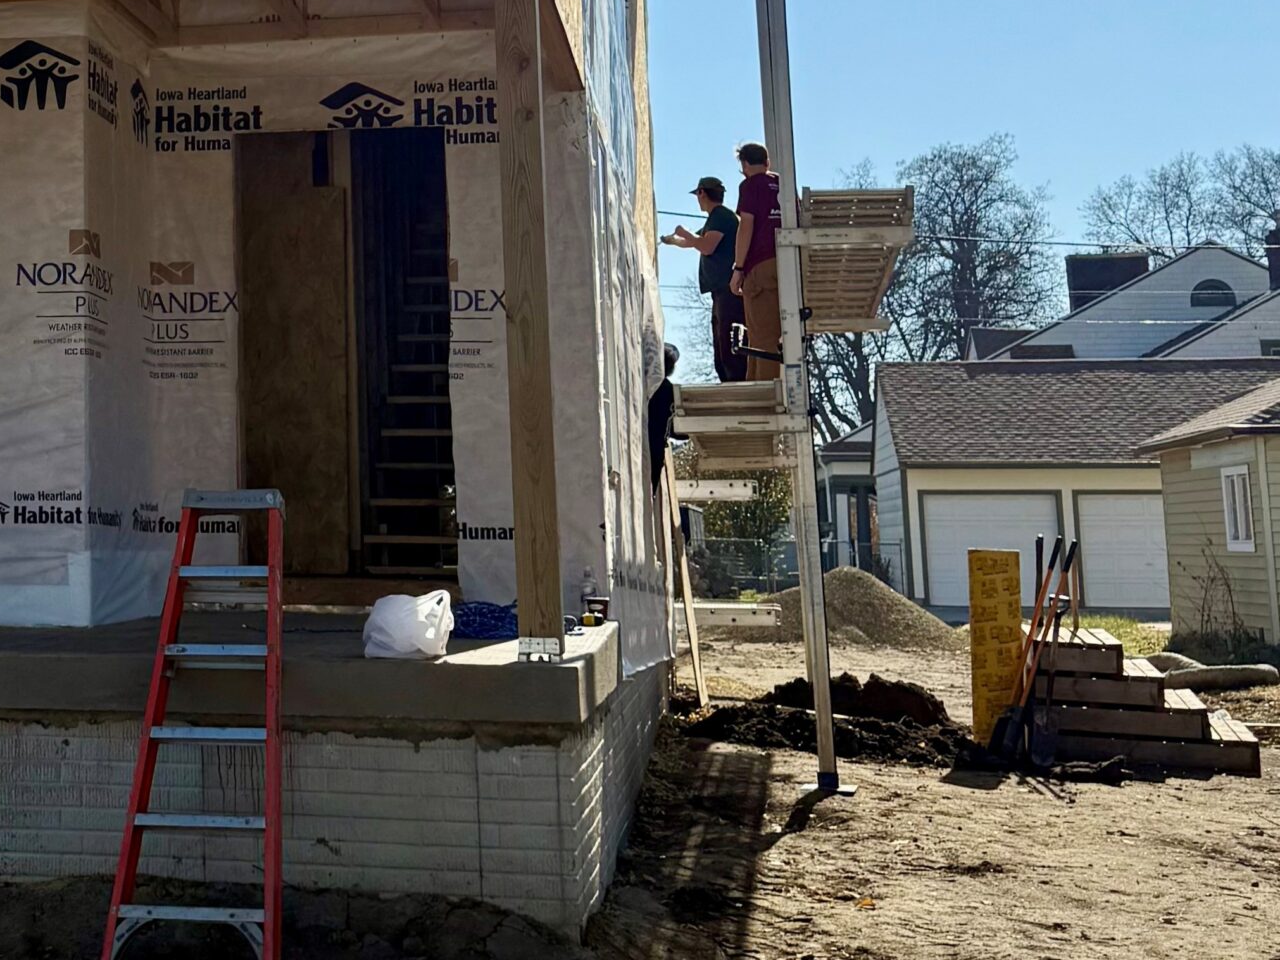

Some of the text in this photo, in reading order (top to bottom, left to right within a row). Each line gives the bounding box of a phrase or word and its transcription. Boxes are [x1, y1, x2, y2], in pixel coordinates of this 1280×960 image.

[414, 76, 497, 94] Iowa Heartla
[156, 86, 247, 101] Iowa Heartland
[155, 104, 263, 133] Habitat
[413, 95, 498, 126] Habit
[155, 136, 231, 152] for Huma
[446, 128, 500, 145] Huma
[16, 262, 114, 295] NORANDEX
[75, 296, 100, 317] PLUS
[48, 323, 82, 332] WEATHER
[64, 348, 78, 356] ICC
[188, 348, 214, 356] BARRIER
[452, 348, 481, 356] BARRIER
[14, 490, 82, 502] Iowa Heartland
[13, 506, 83, 525] Habitat
